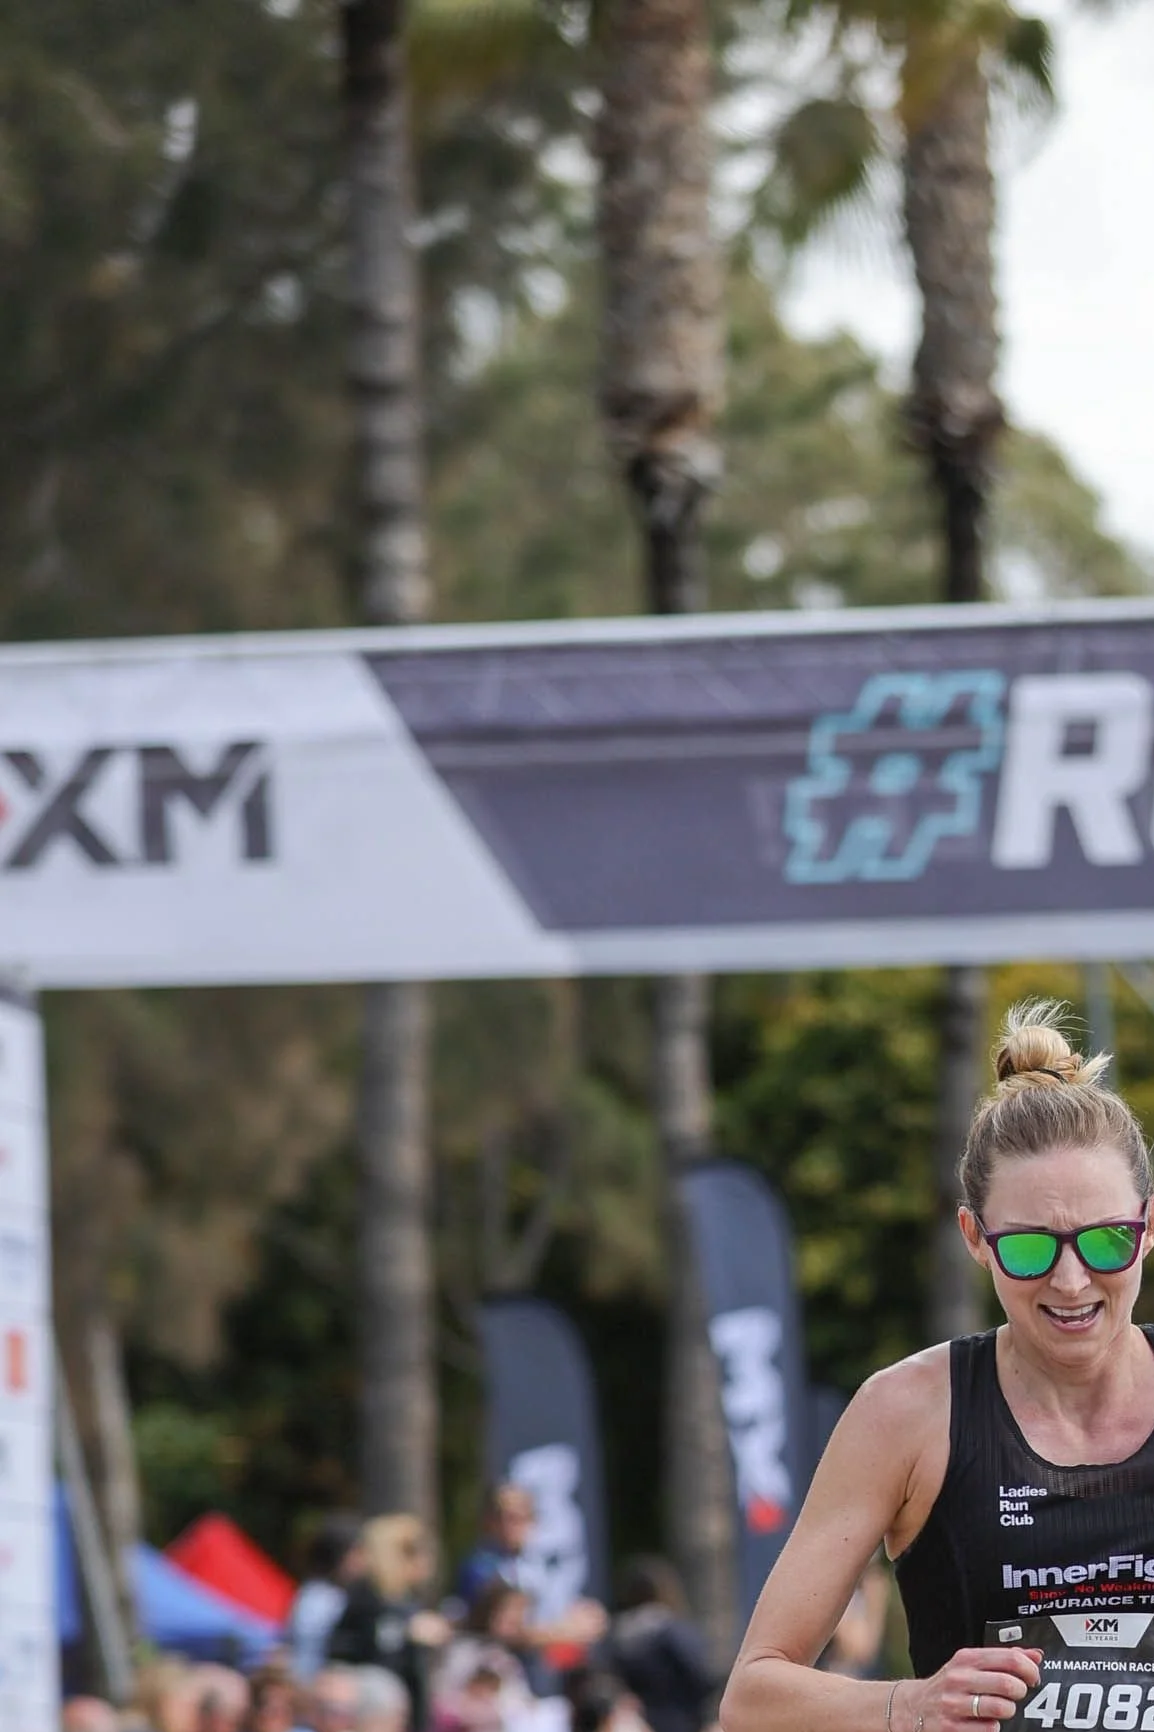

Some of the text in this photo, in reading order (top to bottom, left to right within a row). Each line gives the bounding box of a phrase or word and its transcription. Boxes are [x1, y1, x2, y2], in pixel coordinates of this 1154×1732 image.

[0, 740, 272, 868] XM
[999, 1485, 1048, 1498] Ladies
[999, 1500, 1029, 1512] Run
[999, 1513, 1034, 1527] Club
[1088, 1619, 1118, 1632] XM
[1043, 1660, 1062, 1670] XM
[1064, 1661, 1126, 1672] MARATHON
